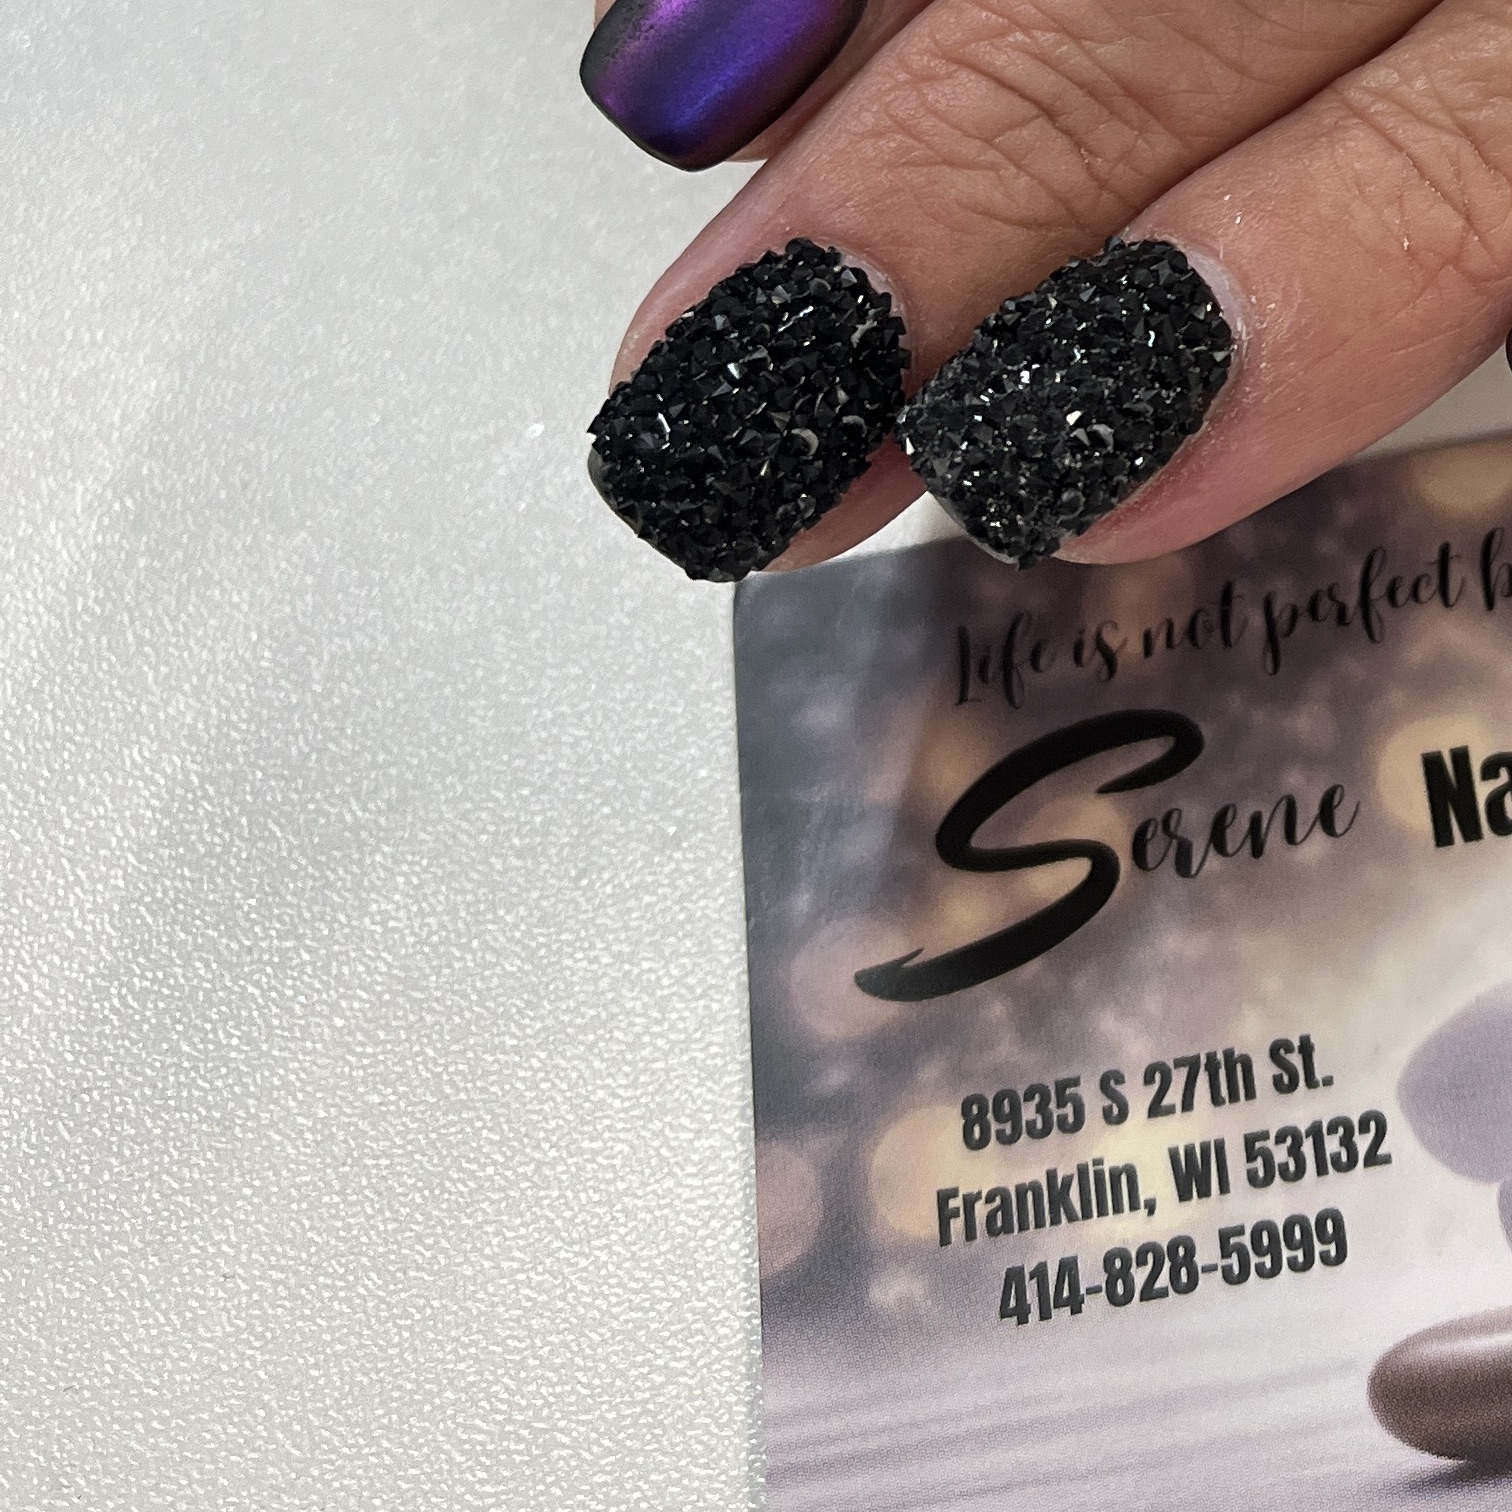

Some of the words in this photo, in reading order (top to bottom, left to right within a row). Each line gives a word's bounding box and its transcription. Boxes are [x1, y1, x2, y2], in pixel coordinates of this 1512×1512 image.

[955, 609, 1048, 709] Life
[1072, 615, 1128, 682] is
[1142, 580, 1246, 660] not
[1261, 541, 1466, 676] perfect
[854, 708, 1361, 1002] Serene
[960, 1075, 1086, 1152] 8935
[1101, 1068, 1130, 1126] S
[1143, 1046, 1257, 1120] 27th
[1268, 1033, 1334, 1095] St.
[936, 1156, 1157, 1248] Franklin,
[1168, 1136, 1231, 1203] WI
[1243, 1109, 1393, 1189] 53132
[999, 1207, 1349, 1327] 414-828-5999
